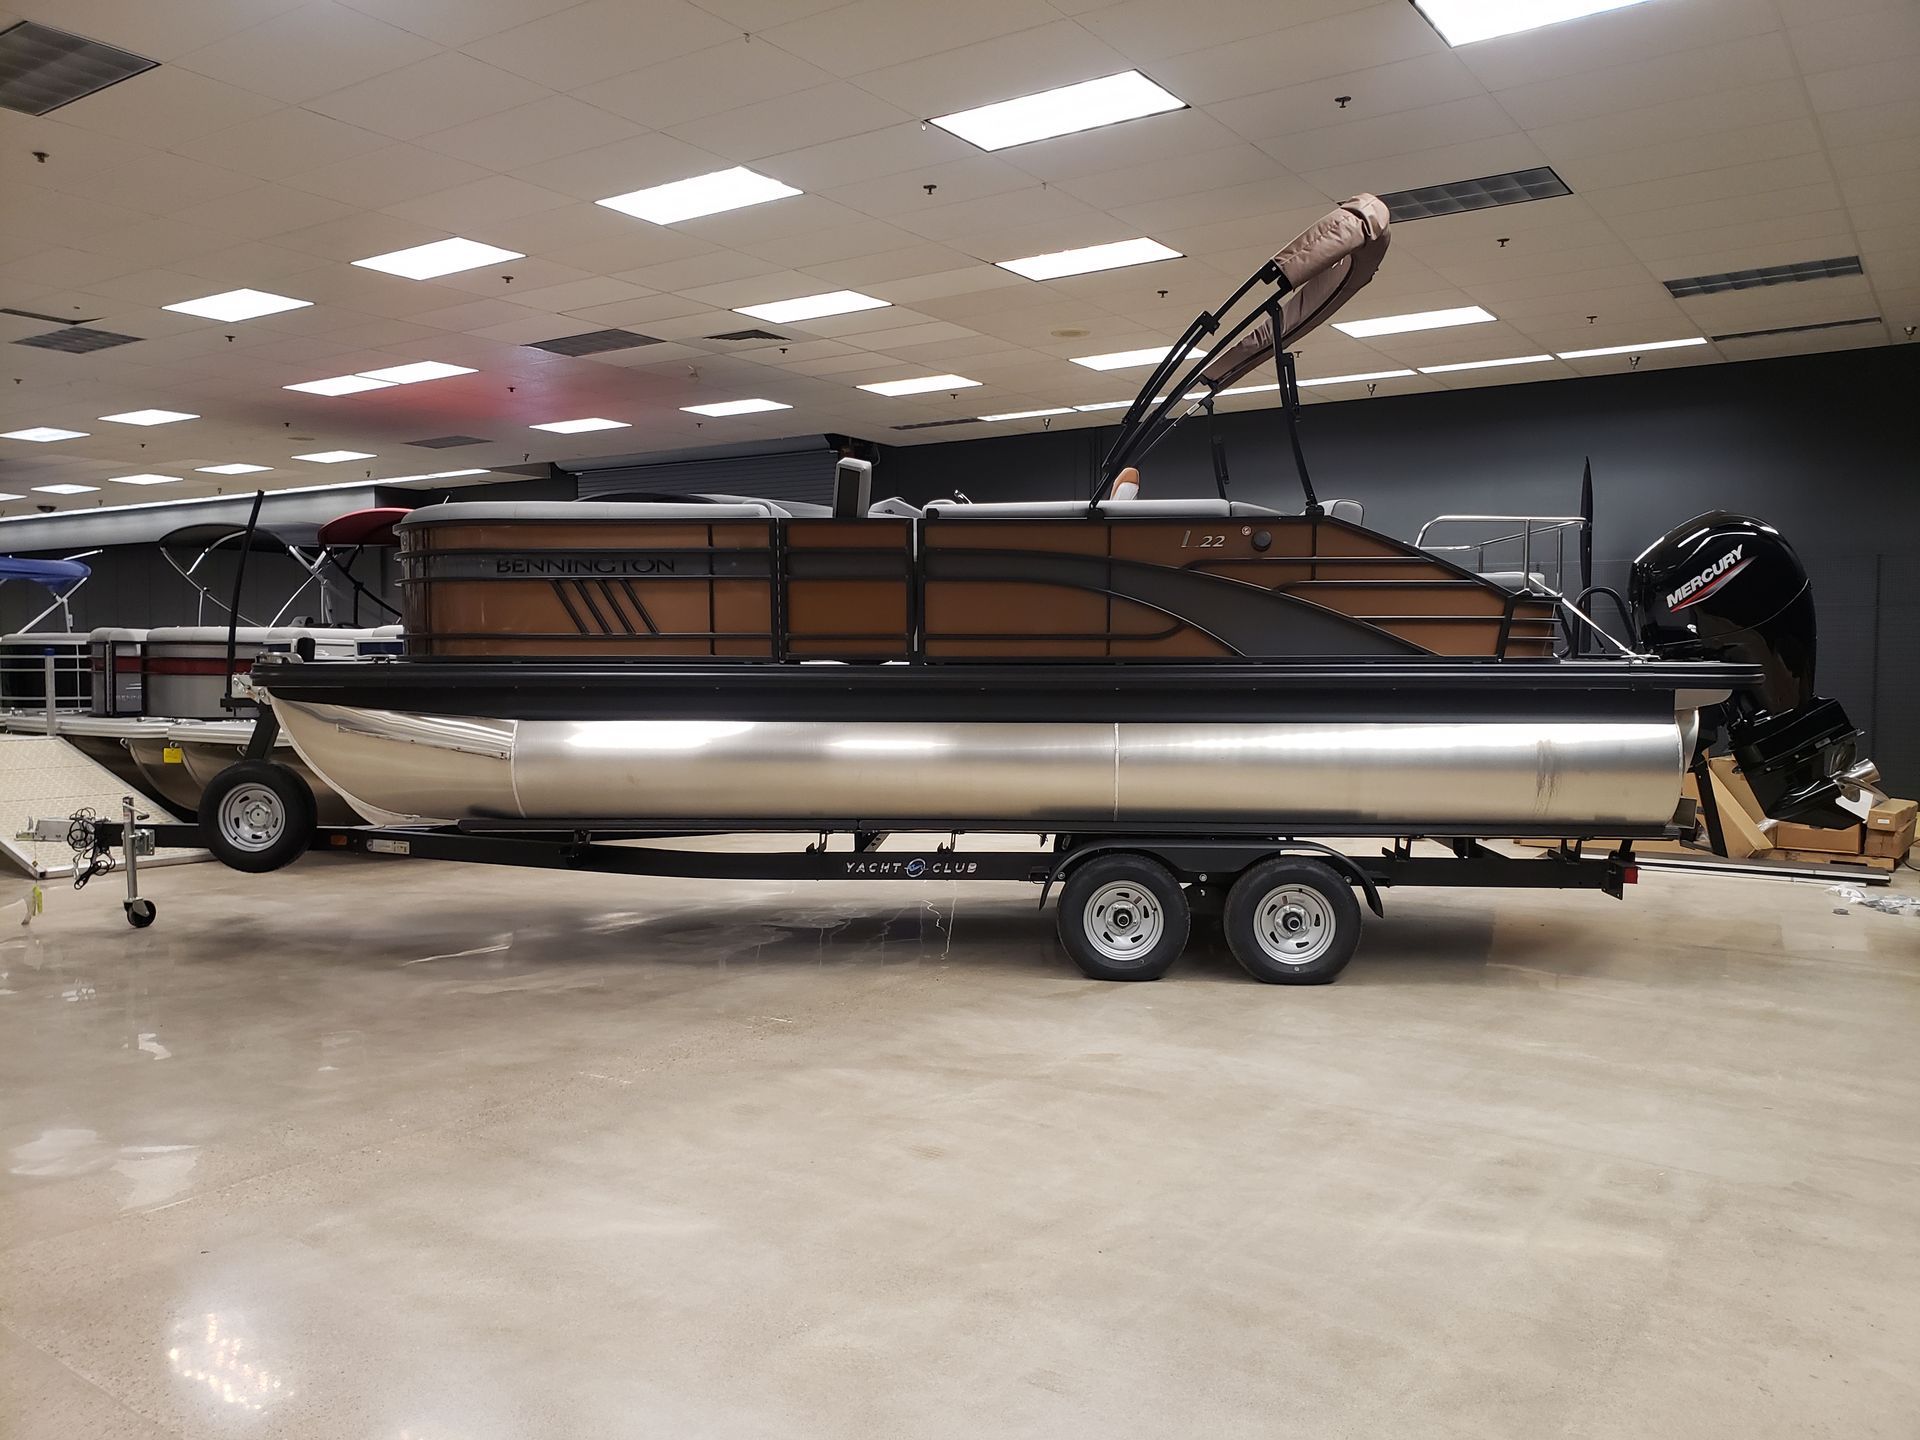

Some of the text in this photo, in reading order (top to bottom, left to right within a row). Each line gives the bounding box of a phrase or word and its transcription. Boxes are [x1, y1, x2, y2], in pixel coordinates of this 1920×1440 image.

[1200, 535, 1226, 548] 22
[496, 558, 675, 573] BENNINGTON
[1666, 544, 1743, 608] MERCURY
[846, 862, 978, 873] YACHT CLUB
